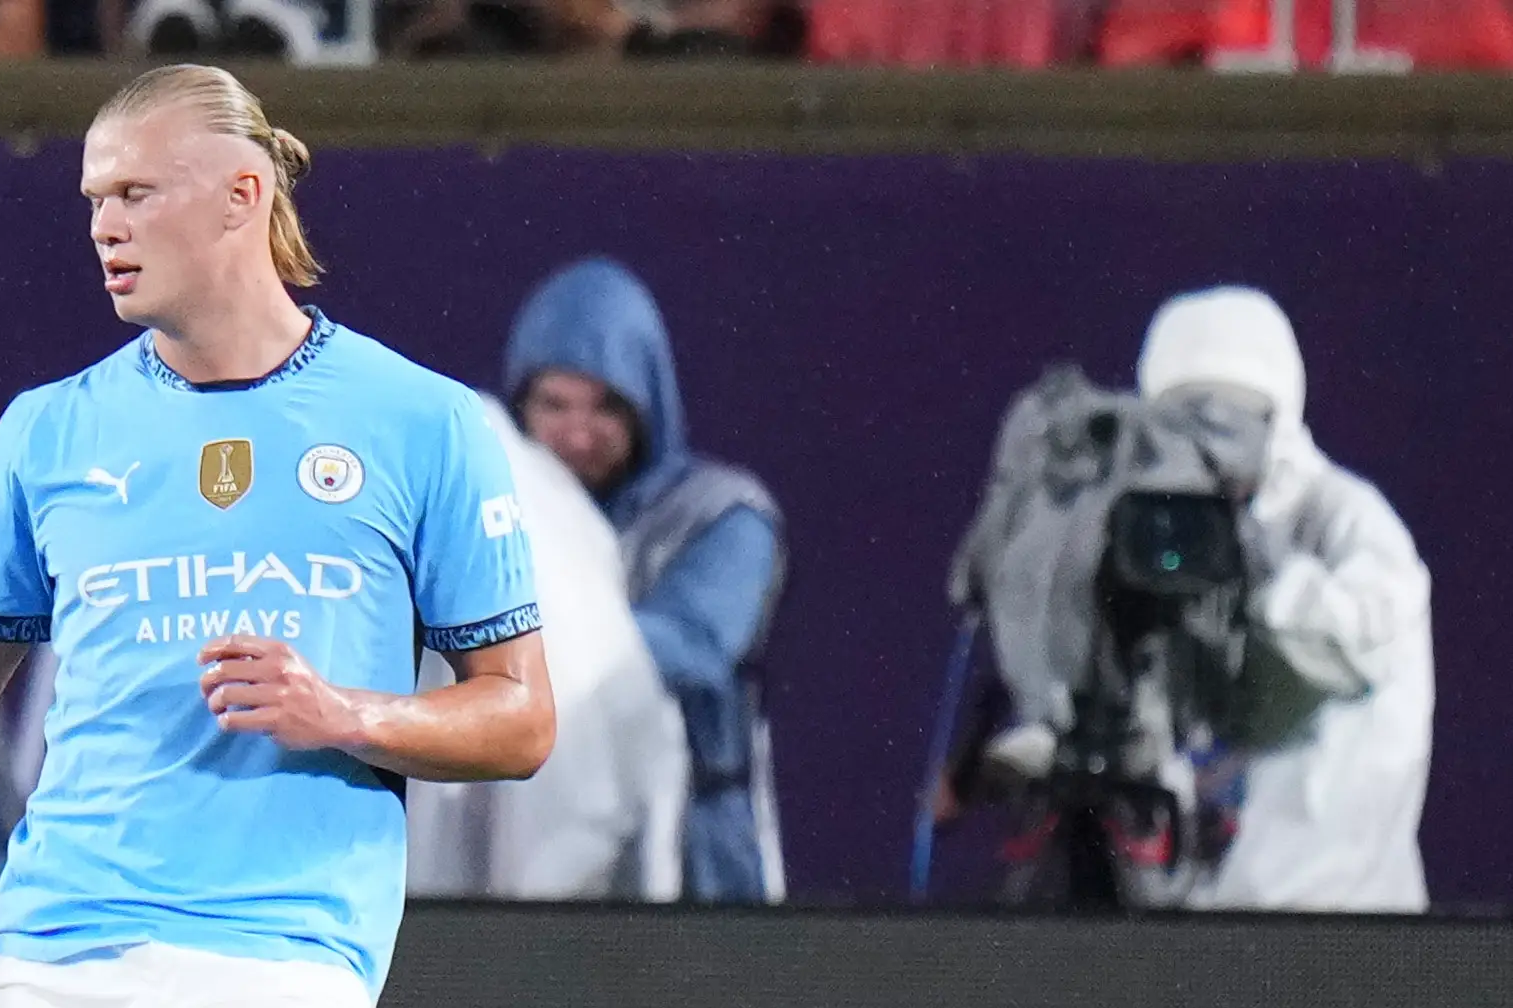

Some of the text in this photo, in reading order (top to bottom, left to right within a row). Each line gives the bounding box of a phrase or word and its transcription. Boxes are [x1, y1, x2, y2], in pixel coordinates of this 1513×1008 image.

[213, 482, 238, 494] FIFA
[77, 551, 364, 608] ETIHAD
[136, 609, 302, 643] AIRWAYS
